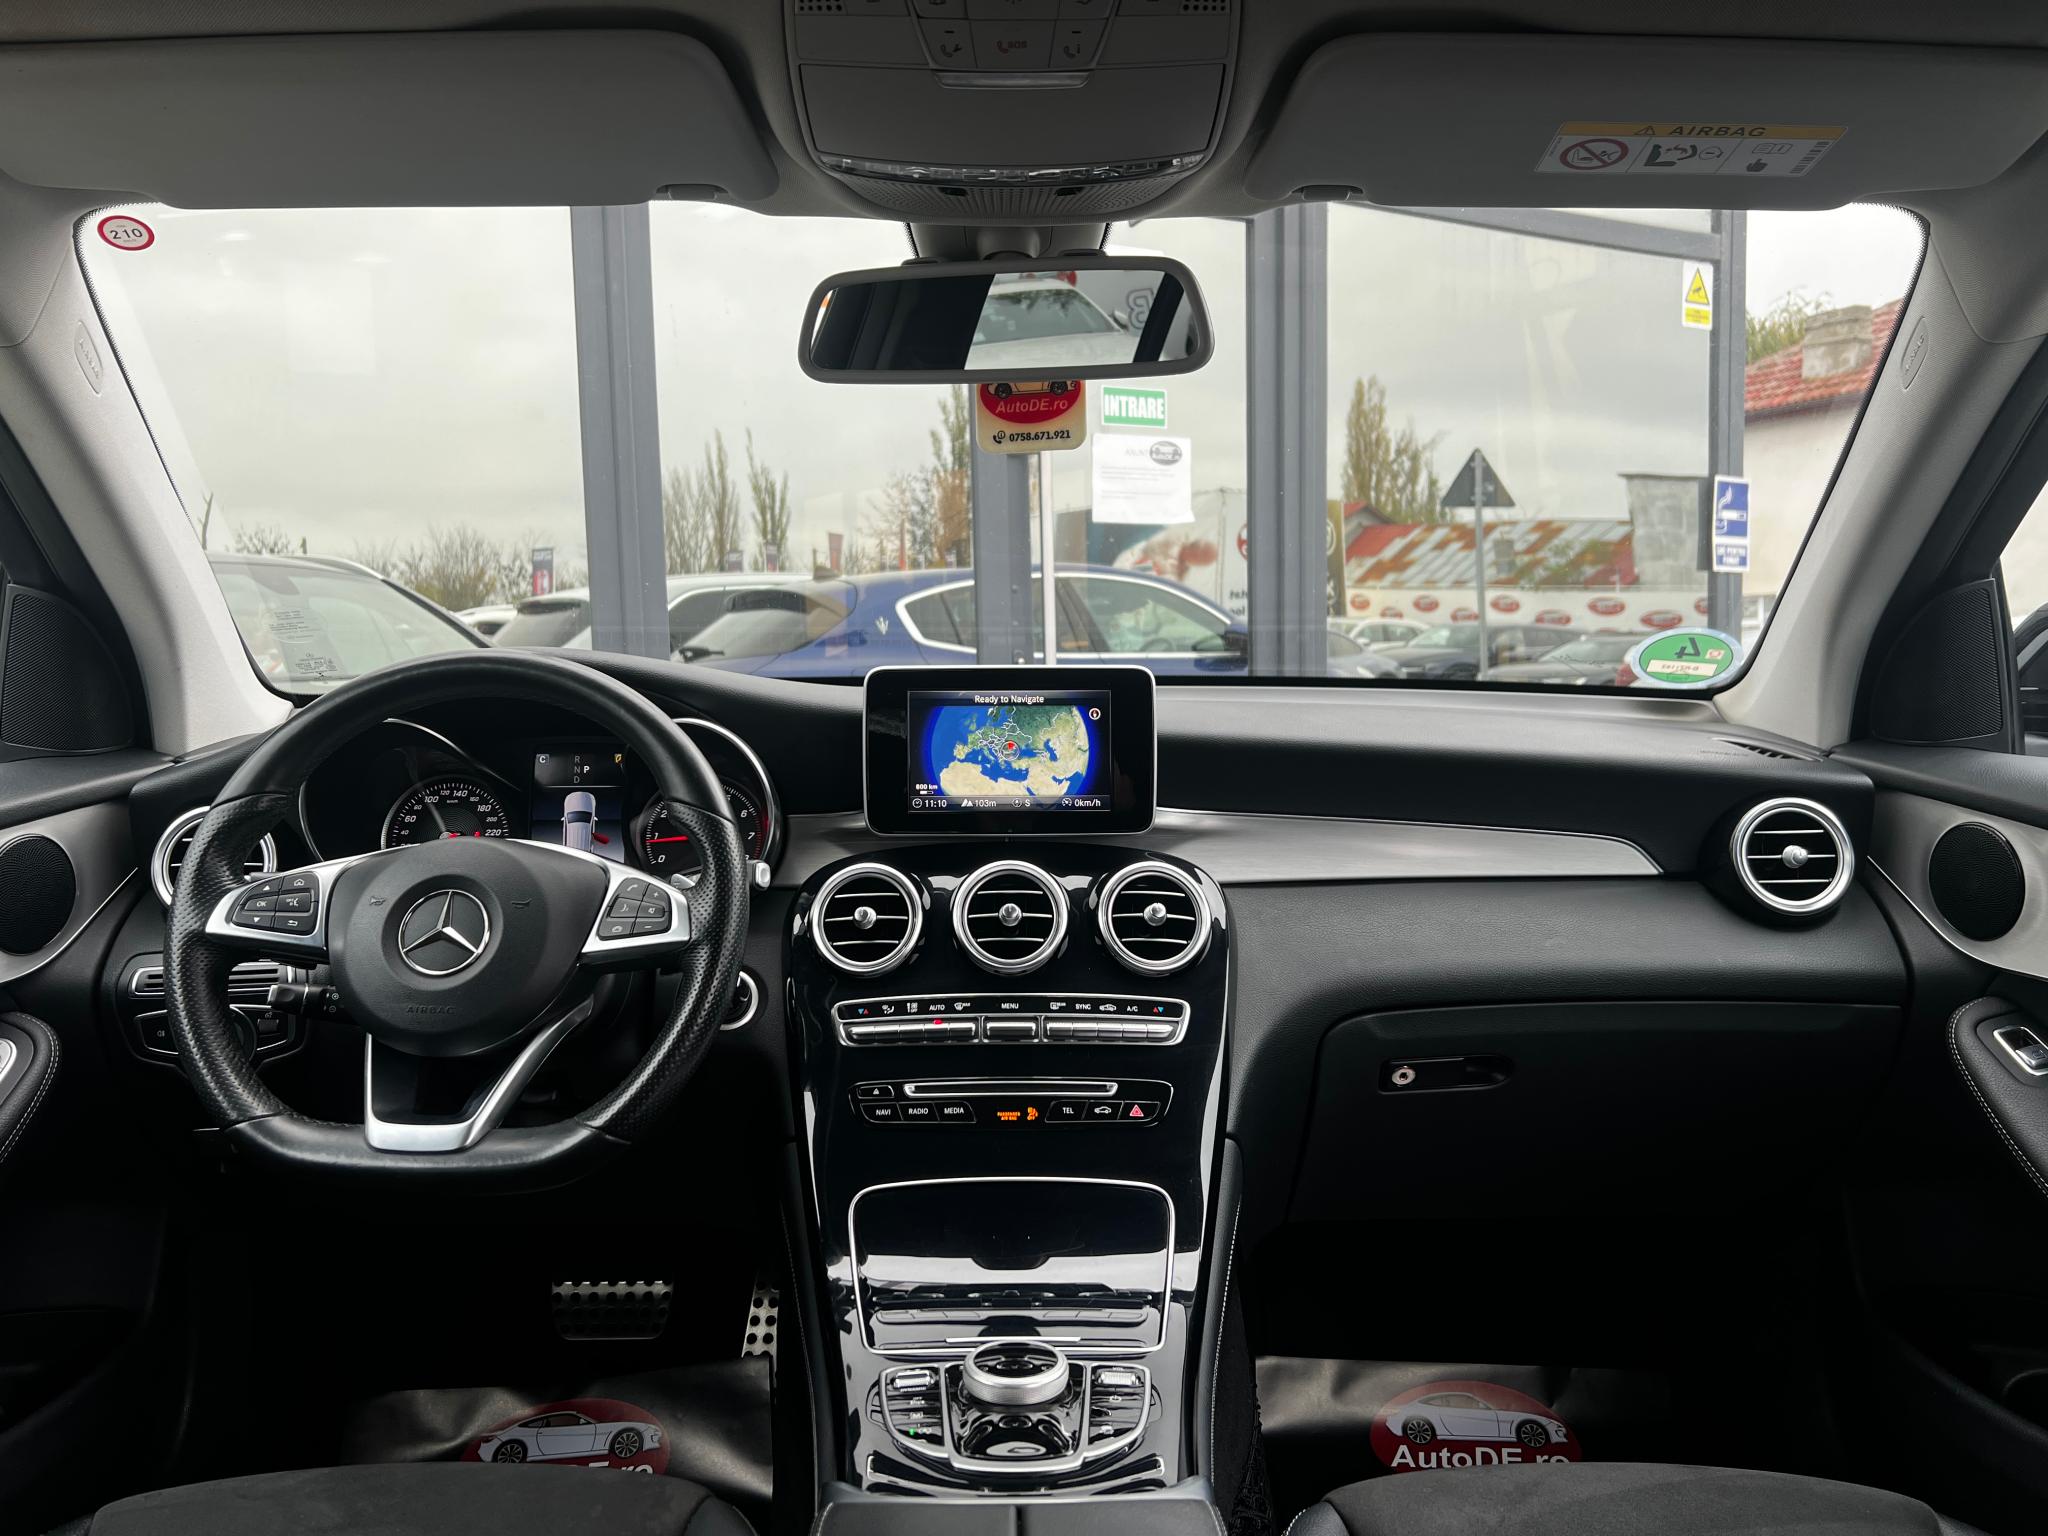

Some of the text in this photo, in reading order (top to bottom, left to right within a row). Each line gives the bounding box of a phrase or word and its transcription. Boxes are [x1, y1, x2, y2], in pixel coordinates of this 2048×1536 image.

[1668, 125, 1767, 137] AIRBAG
[109, 228, 143, 240] 210
[995, 398, 1068, 414] AutoDE.ro
[1103, 393, 1166, 420] INTRARE
[1009, 430, 1071, 442] 0758.671.921
[974, 694, 1045, 705] Ready to Navigate
[539, 755, 546, 764] C
[583, 765, 590, 774] P
[573, 775, 580, 784] D
[928, 783, 938, 791] km
[924, 799, 947, 808] 11:10
[974, 799, 997, 808] 103m
[1024, 799, 1031, 807] S
[1074, 798, 1101, 807] 0km/h
[477, 804, 492, 812] 180
[659, 810, 668, 818] 2
[740, 810, 748, 818] 6
[404, 815, 417, 823] 60
[747, 832, 756, 840] 7
[657, 854, 666, 863] 0
[1001, 1002, 1019, 1010] MENU
[875, 1108, 892, 1116] NAVI
[908, 1107, 929, 1115] RADIO
[943, 1106, 965, 1114] MEDIA
[1062, 1106, 1075, 1114] TEL
[1390, 1444, 1570, 1470] AutoDEro
